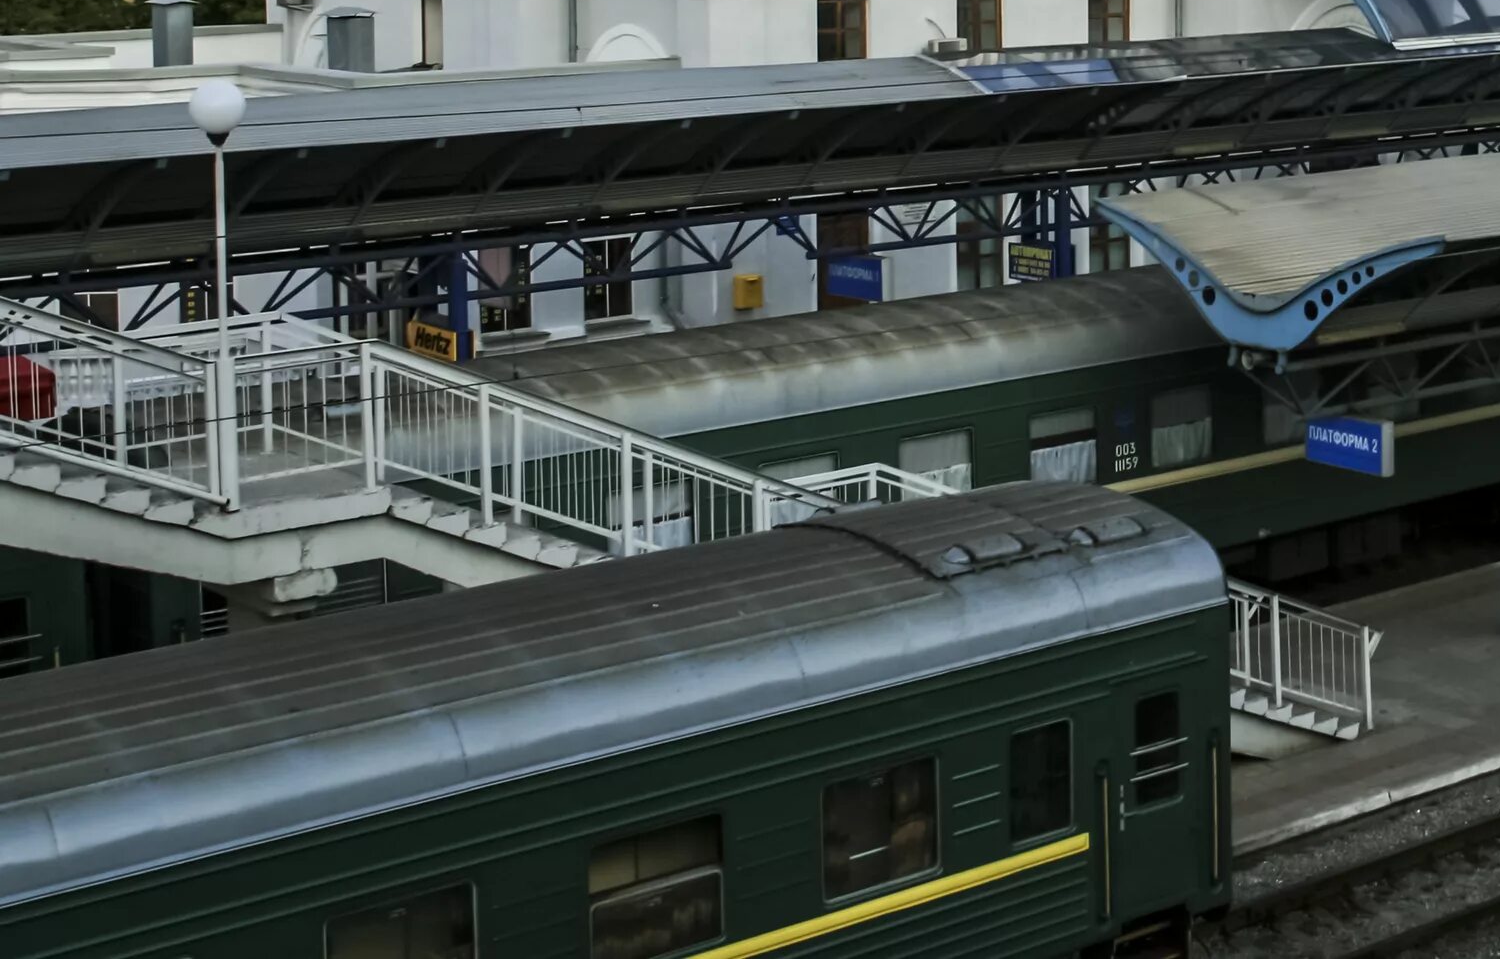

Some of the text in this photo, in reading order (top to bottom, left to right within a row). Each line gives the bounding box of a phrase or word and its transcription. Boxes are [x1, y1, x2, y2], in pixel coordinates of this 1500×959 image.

[414, 326, 452, 355] Hertz
[1115, 442, 1137, 457] 003
[1308, 425, 1379, 454] ПЛАТФОРМА 2
[1114, 456, 1139, 473] 11159
